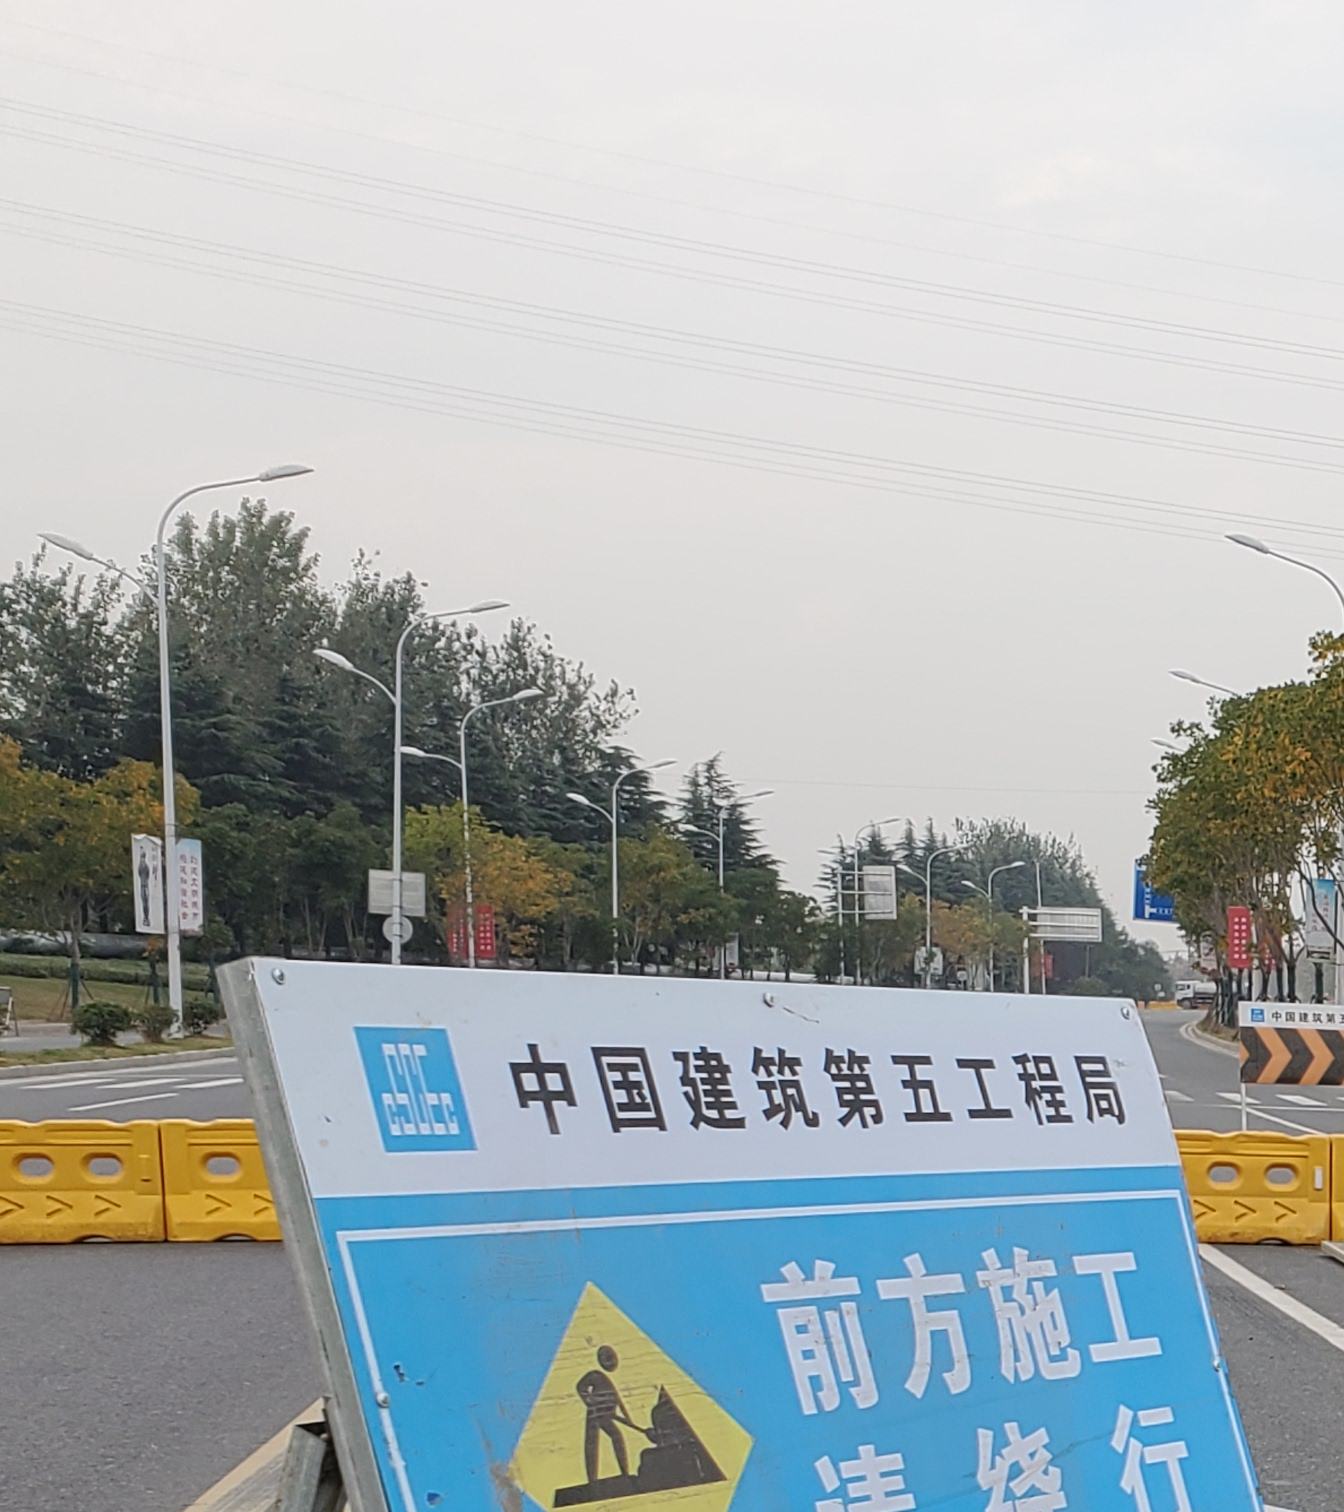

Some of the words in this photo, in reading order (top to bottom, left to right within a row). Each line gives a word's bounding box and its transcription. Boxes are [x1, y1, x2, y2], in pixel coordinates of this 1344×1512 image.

[507, 1042, 1130, 1136] 中国建筑第五工程局
[760, 1246, 1162, 1416] 前方施工
